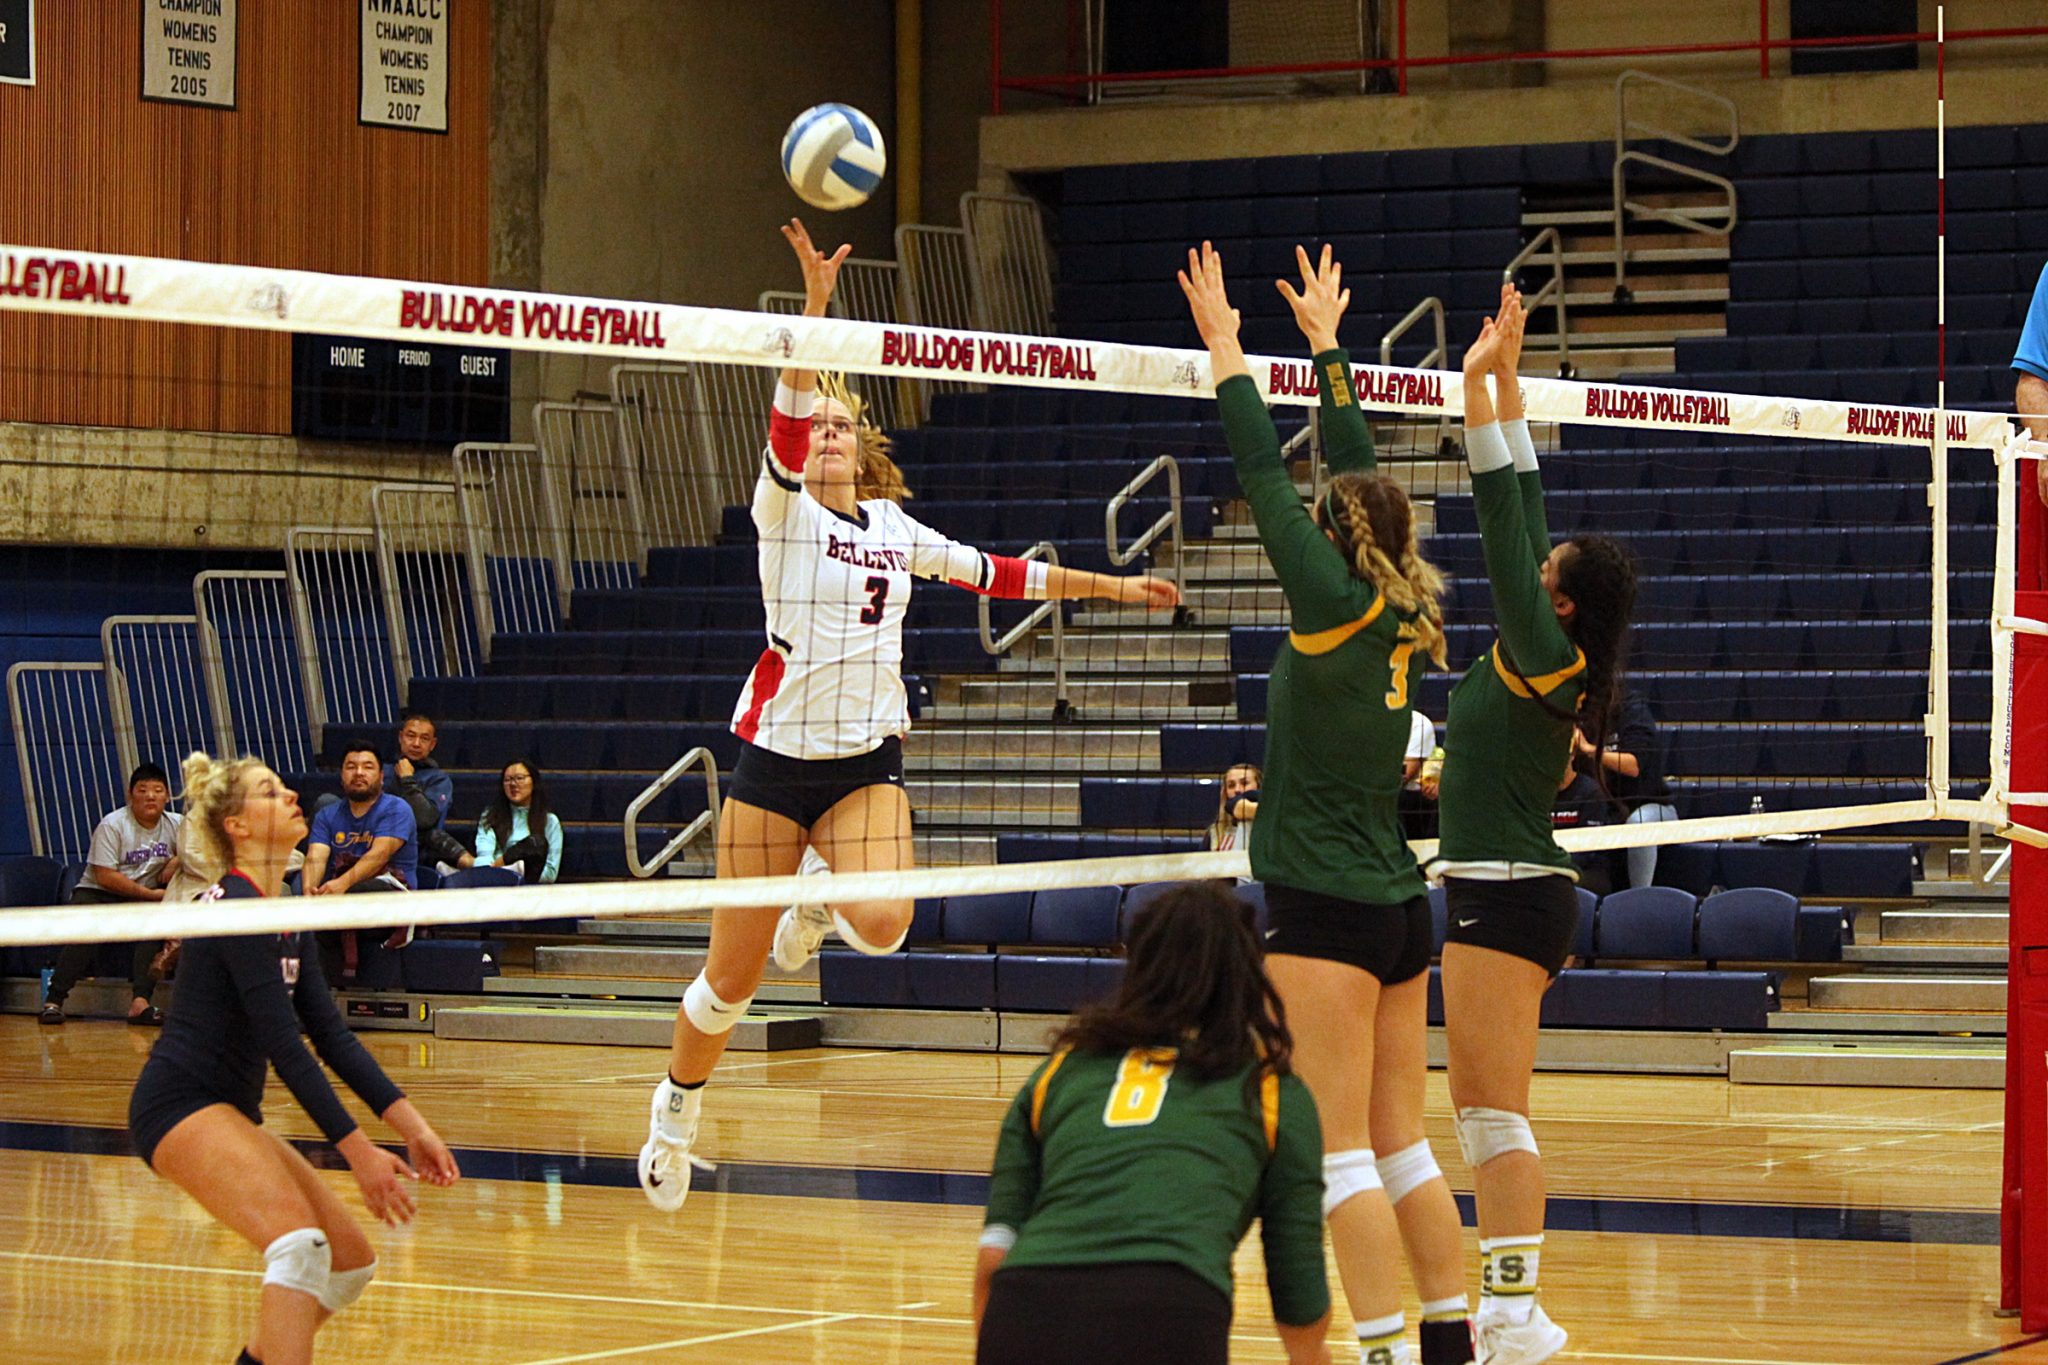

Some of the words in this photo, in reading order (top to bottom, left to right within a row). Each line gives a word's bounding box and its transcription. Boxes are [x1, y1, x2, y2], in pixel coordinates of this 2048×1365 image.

[163, 18, 217, 43] WOMENS
[376, 21, 433, 44] CHAMPION
[168, 47, 211, 70] TENNIS
[380, 48, 429, 70] WOMENS
[171, 75, 207, 97] 2005
[385, 75, 425, 96] TENNIS
[388, 102, 421, 122] 2007
[401, 290, 514, 336] BULLDOG
[521, 300, 666, 347] VOLLEYBALL
[330, 346, 365, 367] HOME
[398, 350, 431, 366] PERIOD
[460, 355, 497, 376] GUEST
[881, 331, 974, 371] BULLDOG
[979, 338, 1096, 381] VOLLEYBALL
[1270, 363, 1320, 397] BULLD
[1586, 388, 1648, 420] BULLDOG
[1650, 392, 1730, 426] VOLLEYBALL
[1847, 407, 1900, 437] BULLDOG
[860, 575, 890, 625] 3
[1385, 643, 1414, 710] 3
[1102, 1046, 1179, 1128] 6
[1500, 1254, 1527, 1284] S
